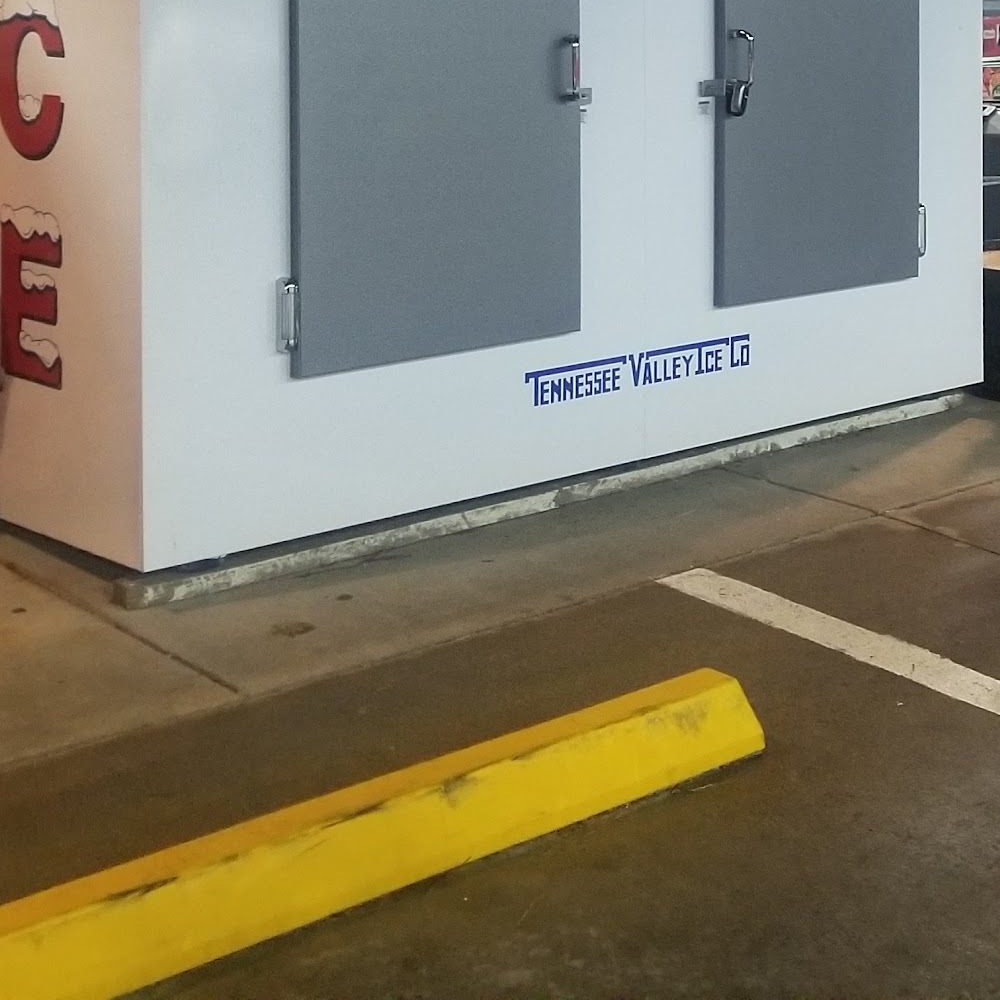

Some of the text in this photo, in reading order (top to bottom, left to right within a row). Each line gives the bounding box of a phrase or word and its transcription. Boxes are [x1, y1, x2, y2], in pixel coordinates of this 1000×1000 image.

[525, 355, 627, 407] TENNESSEE
[628, 351, 694, 388] VALLEY
[730, 333, 750, 368] CO
